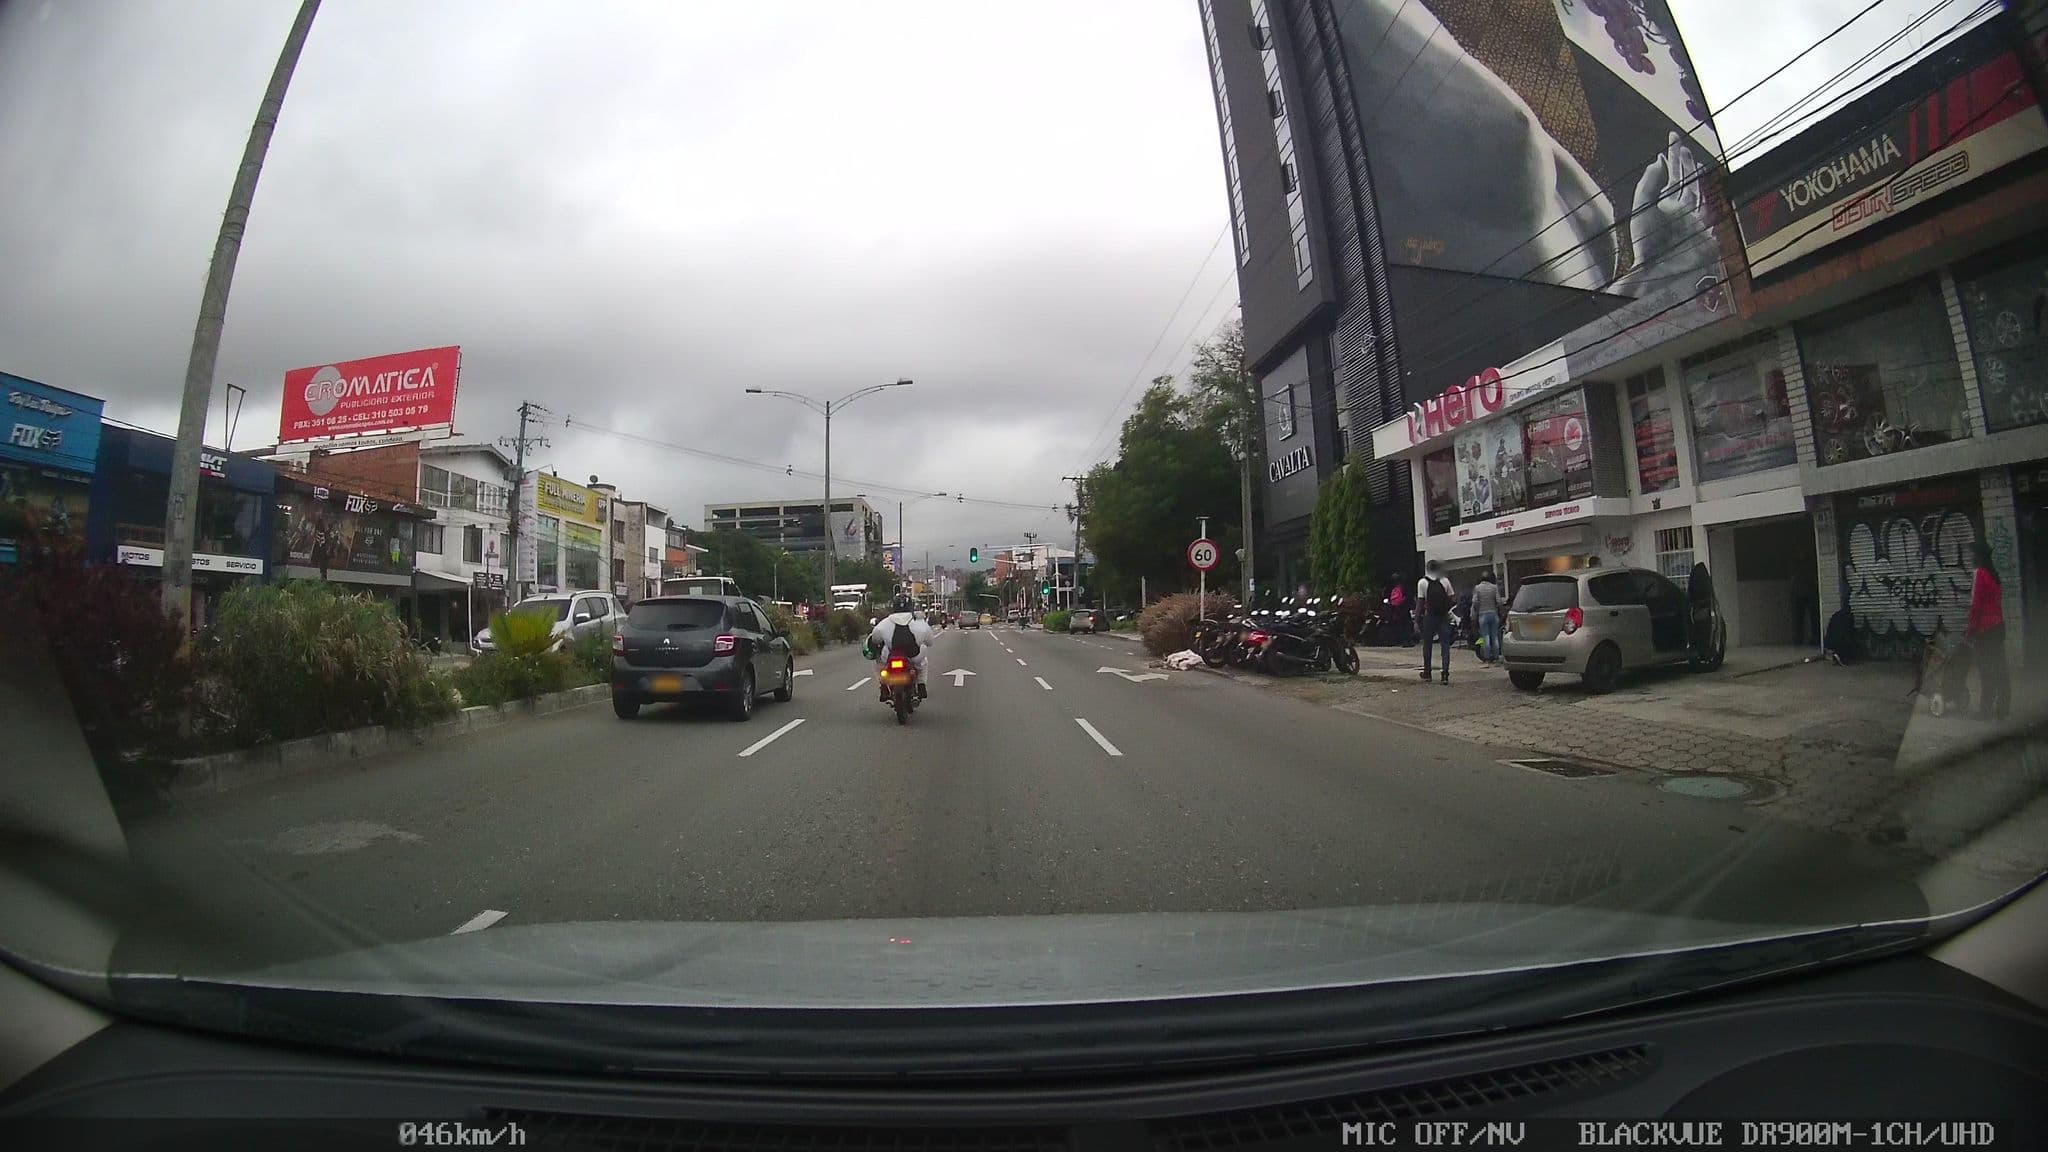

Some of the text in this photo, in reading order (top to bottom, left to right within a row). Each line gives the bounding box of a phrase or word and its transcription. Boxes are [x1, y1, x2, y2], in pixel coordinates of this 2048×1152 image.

[1779, 134, 1901, 212] YOKOHAMA
[391, 391, 435, 404] EXTERIOR
[352, 413, 370, 422] CEL:
[371, 410, 386, 419] 310
[11, 423, 45, 448] FOX
[1269, 445, 1310, 483] CAVALTA
[345, 495, 366, 513] FOX
[120, 551, 150, 561] MOTOS
[225, 560, 257, 570] SERVICIO
[1195, 549, 1212, 561] 60
